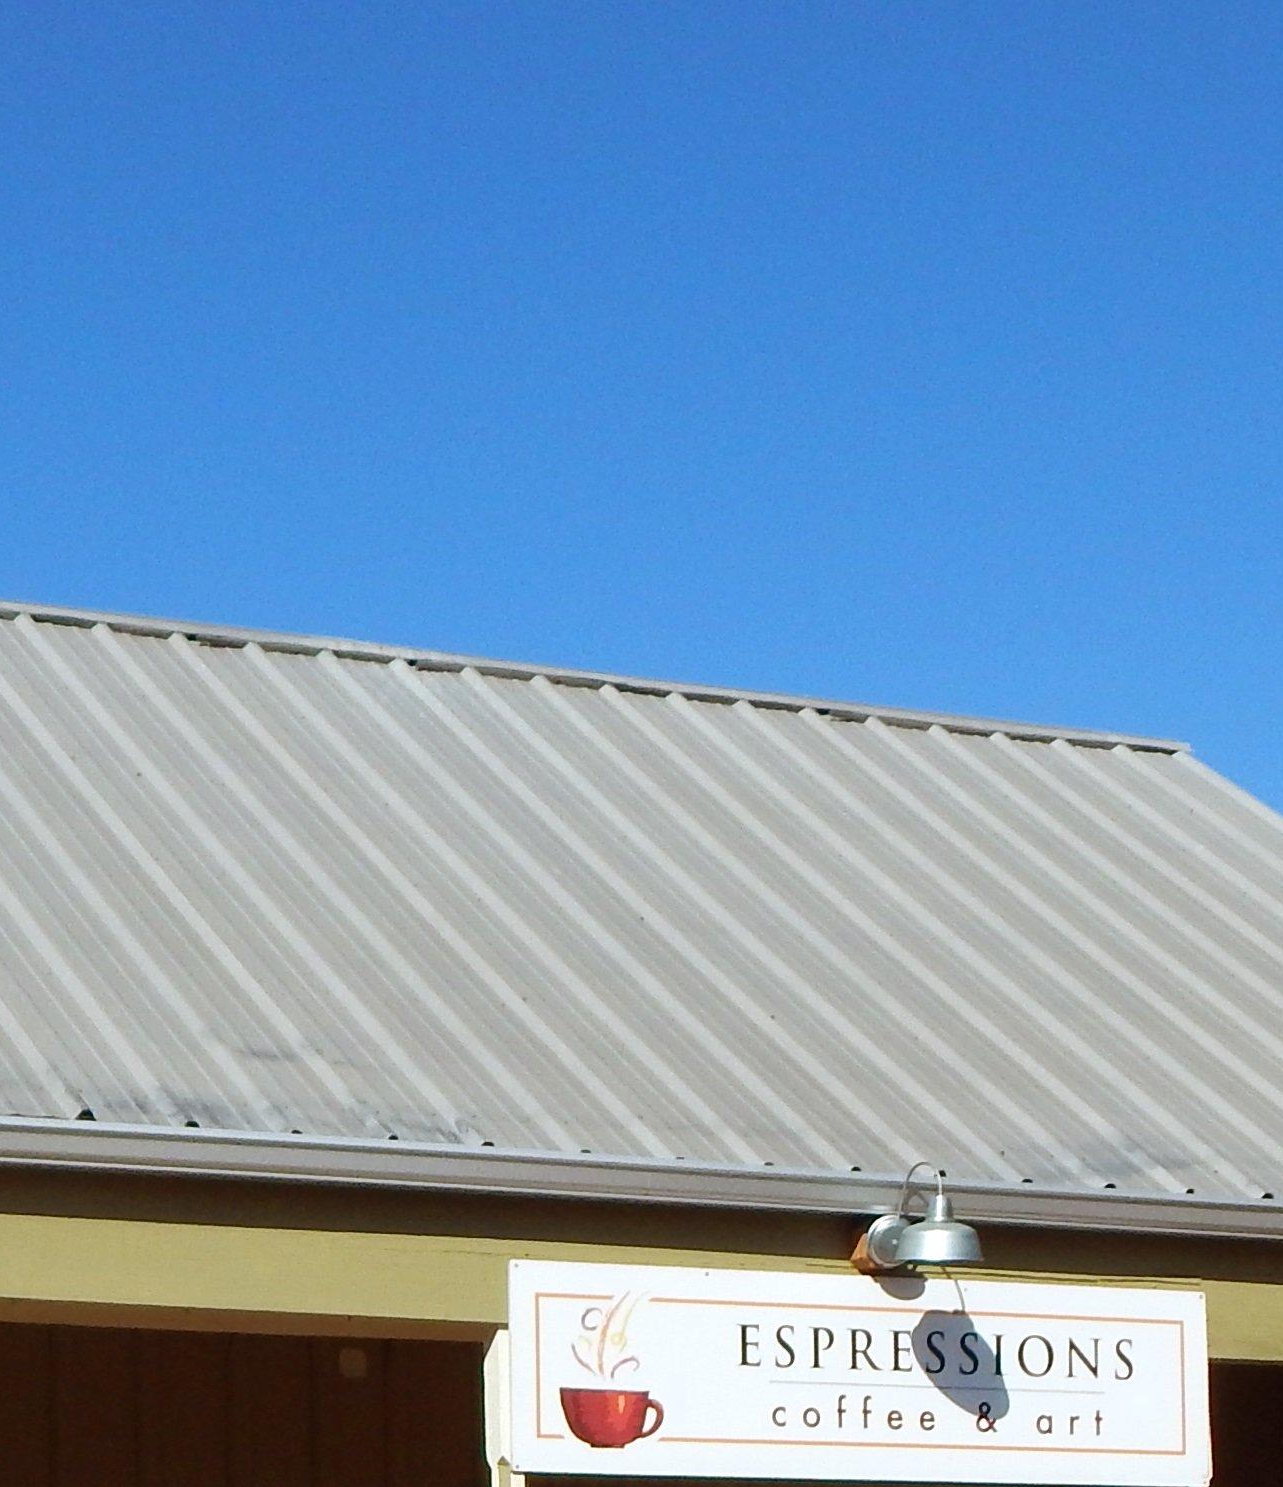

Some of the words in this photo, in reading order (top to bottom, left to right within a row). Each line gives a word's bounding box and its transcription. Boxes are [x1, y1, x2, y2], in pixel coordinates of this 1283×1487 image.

[736, 1322, 1135, 1381] ESPRESSIONS
[771, 1393, 937, 1431] coffee
[975, 1401, 998, 1433] &
[1035, 1409, 1106, 1436] art
